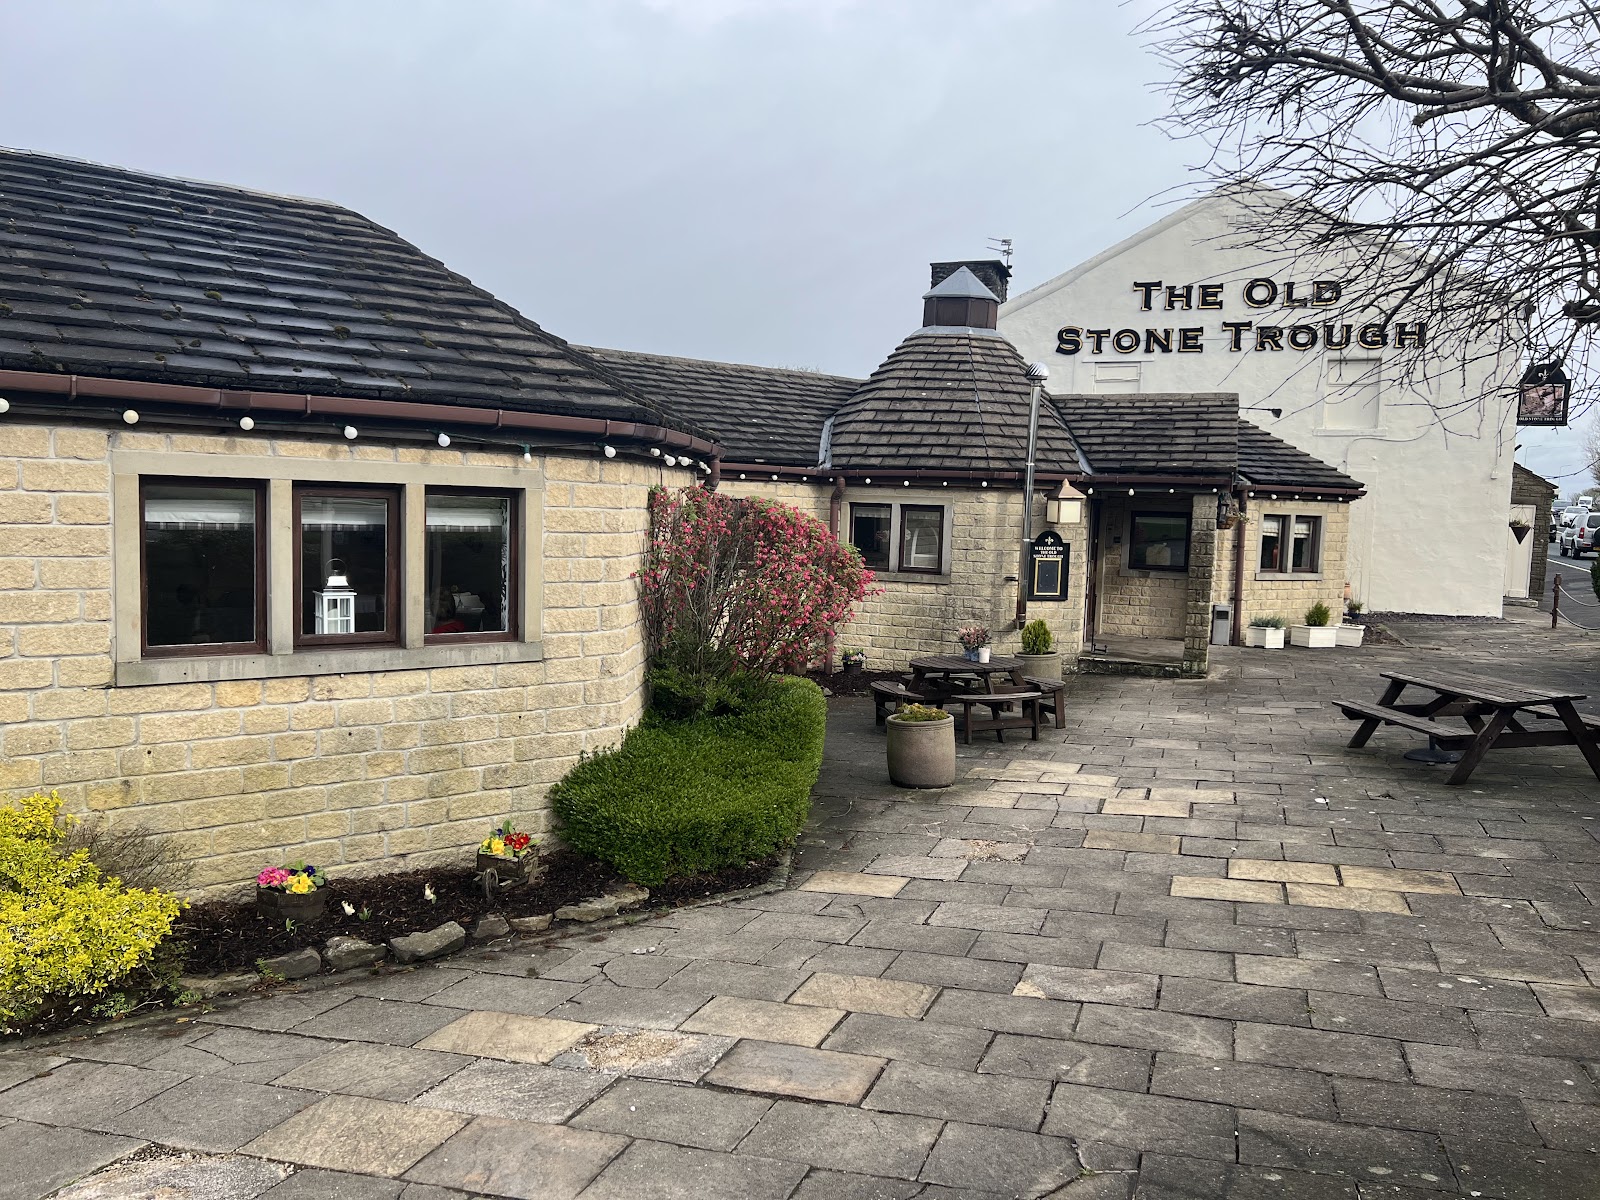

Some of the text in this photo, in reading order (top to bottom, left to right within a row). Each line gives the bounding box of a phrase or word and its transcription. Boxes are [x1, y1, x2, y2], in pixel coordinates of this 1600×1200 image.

[1133, 277, 1342, 311] THE OLD
[1055, 320, 1427, 355] STONE TROUGH
